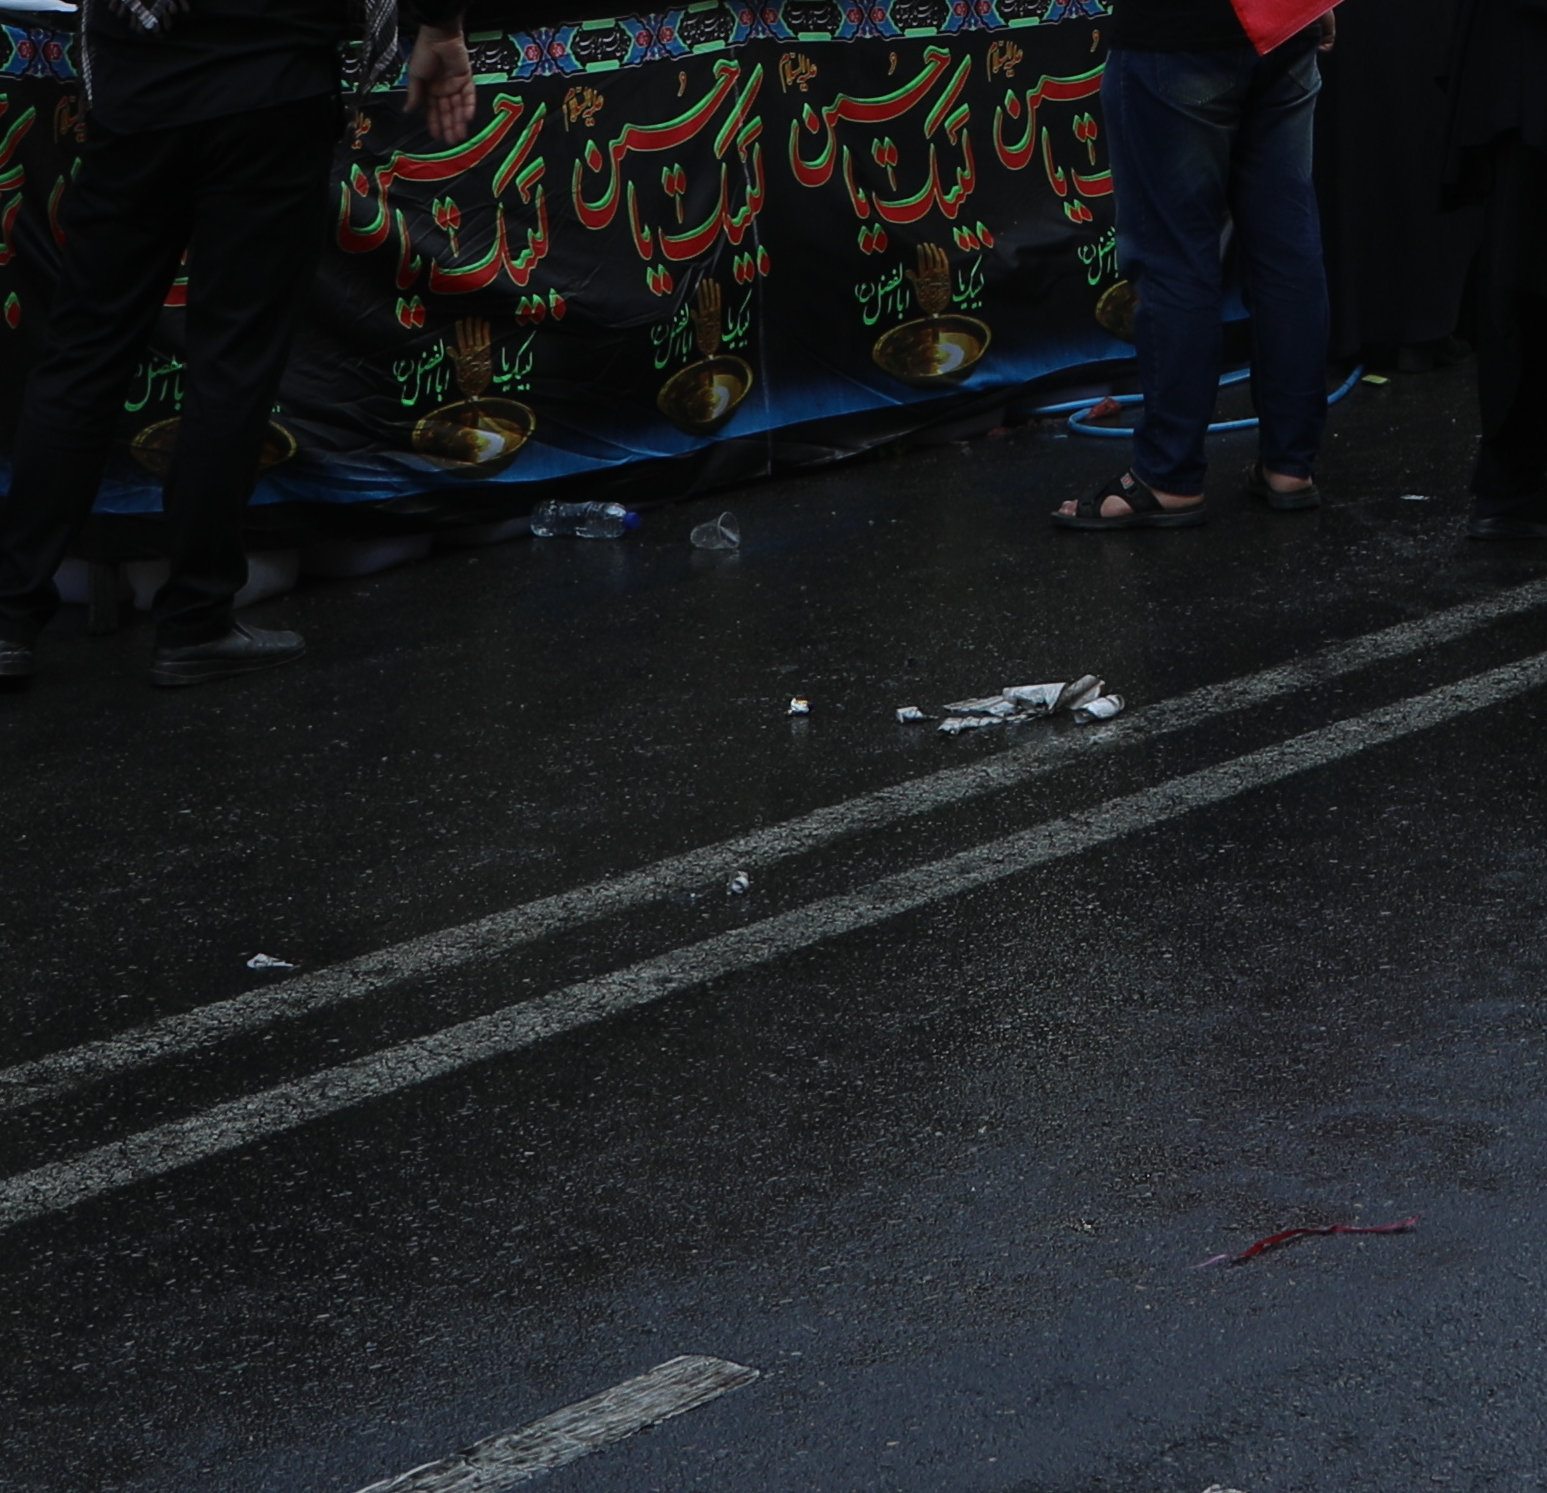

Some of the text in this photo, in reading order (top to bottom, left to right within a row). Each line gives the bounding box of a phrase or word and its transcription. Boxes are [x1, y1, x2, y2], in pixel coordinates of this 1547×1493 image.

[571, 58, 742, 230] حسین
[659, 62, 772, 283] لبیک
[788, 44, 952, 188] حسین
[872, 53, 995, 251] لبیک
[992, 62, 1109, 171] سین
[429, 101, 567, 325] لبیک
